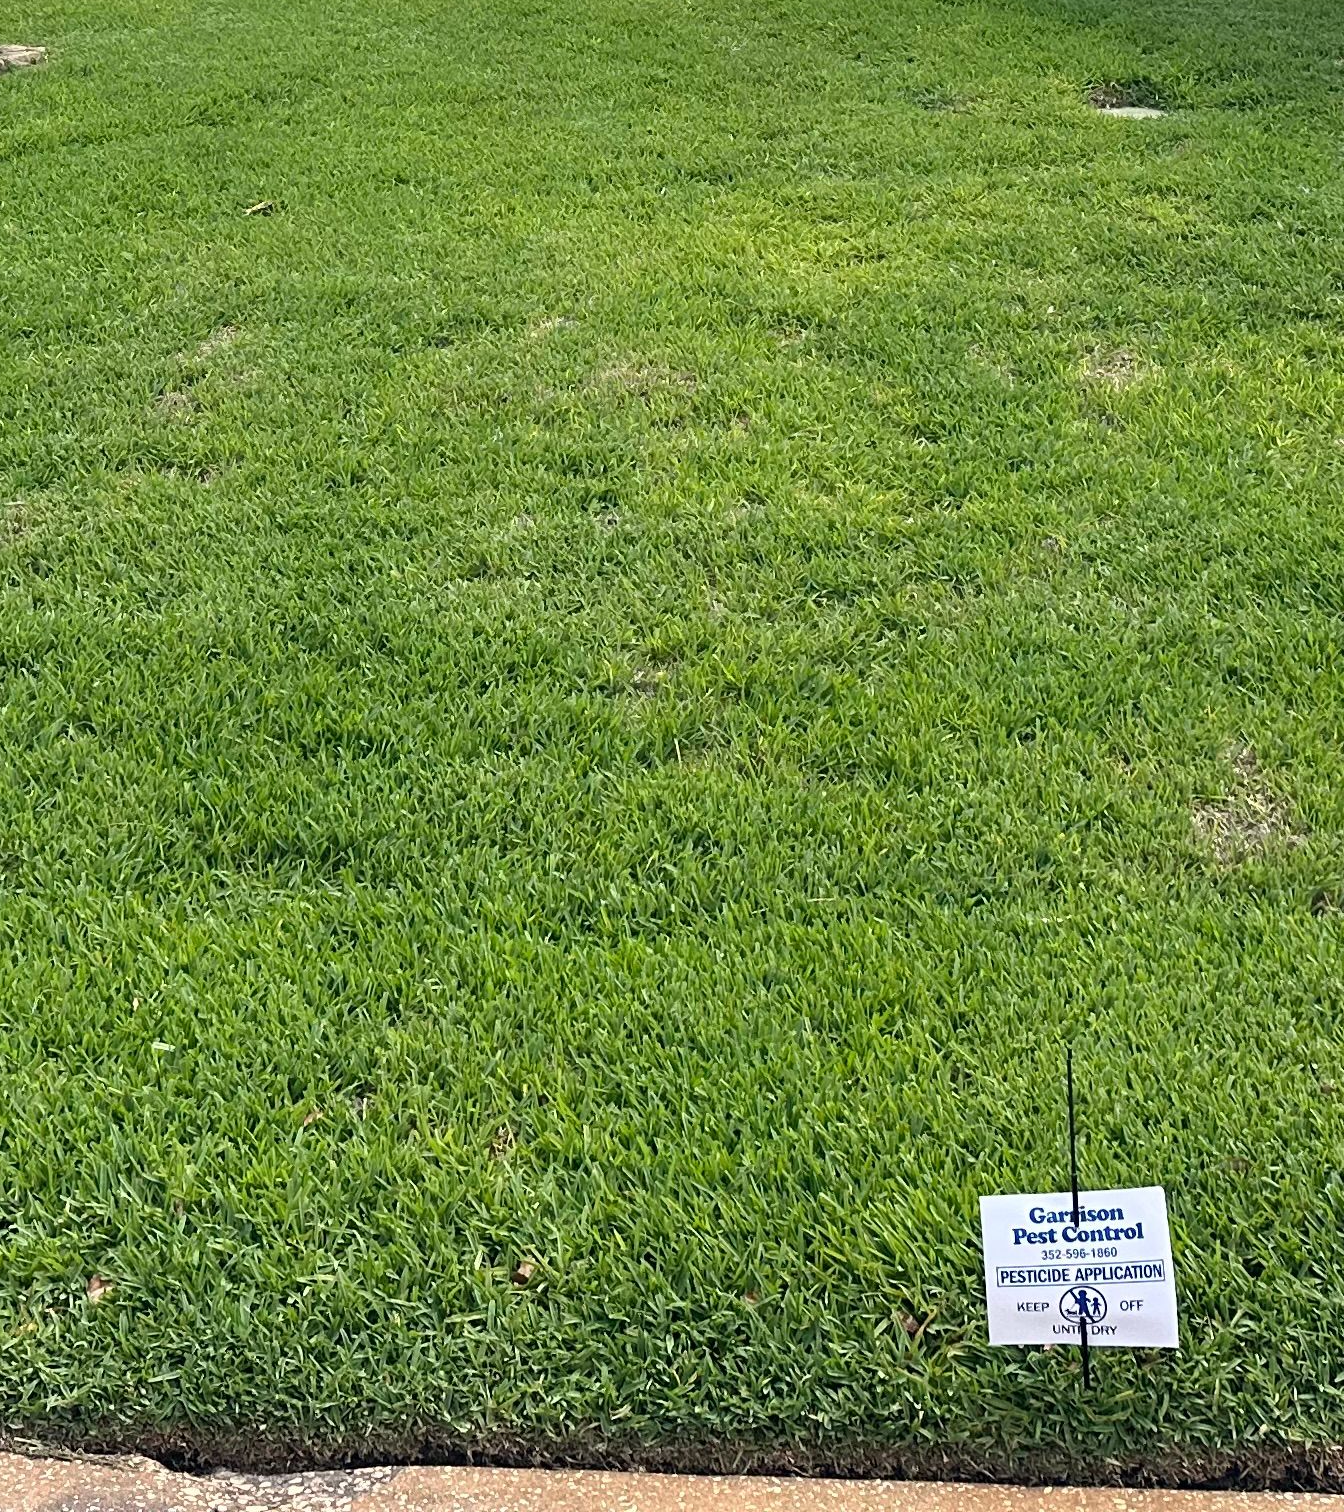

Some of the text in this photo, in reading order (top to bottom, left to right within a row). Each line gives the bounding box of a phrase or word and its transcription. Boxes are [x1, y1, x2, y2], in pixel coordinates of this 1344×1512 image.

[1012, 1222, 1144, 1245] Pest Control
[1041, 1246, 1118, 1261] 352-596-1860
[1000, 1264, 1162, 1284] PESTICIDE APPLICATION
[1017, 1300, 1144, 1312] KEEP OFF
[1053, 1324, 1118, 1335] UNTI DRY
